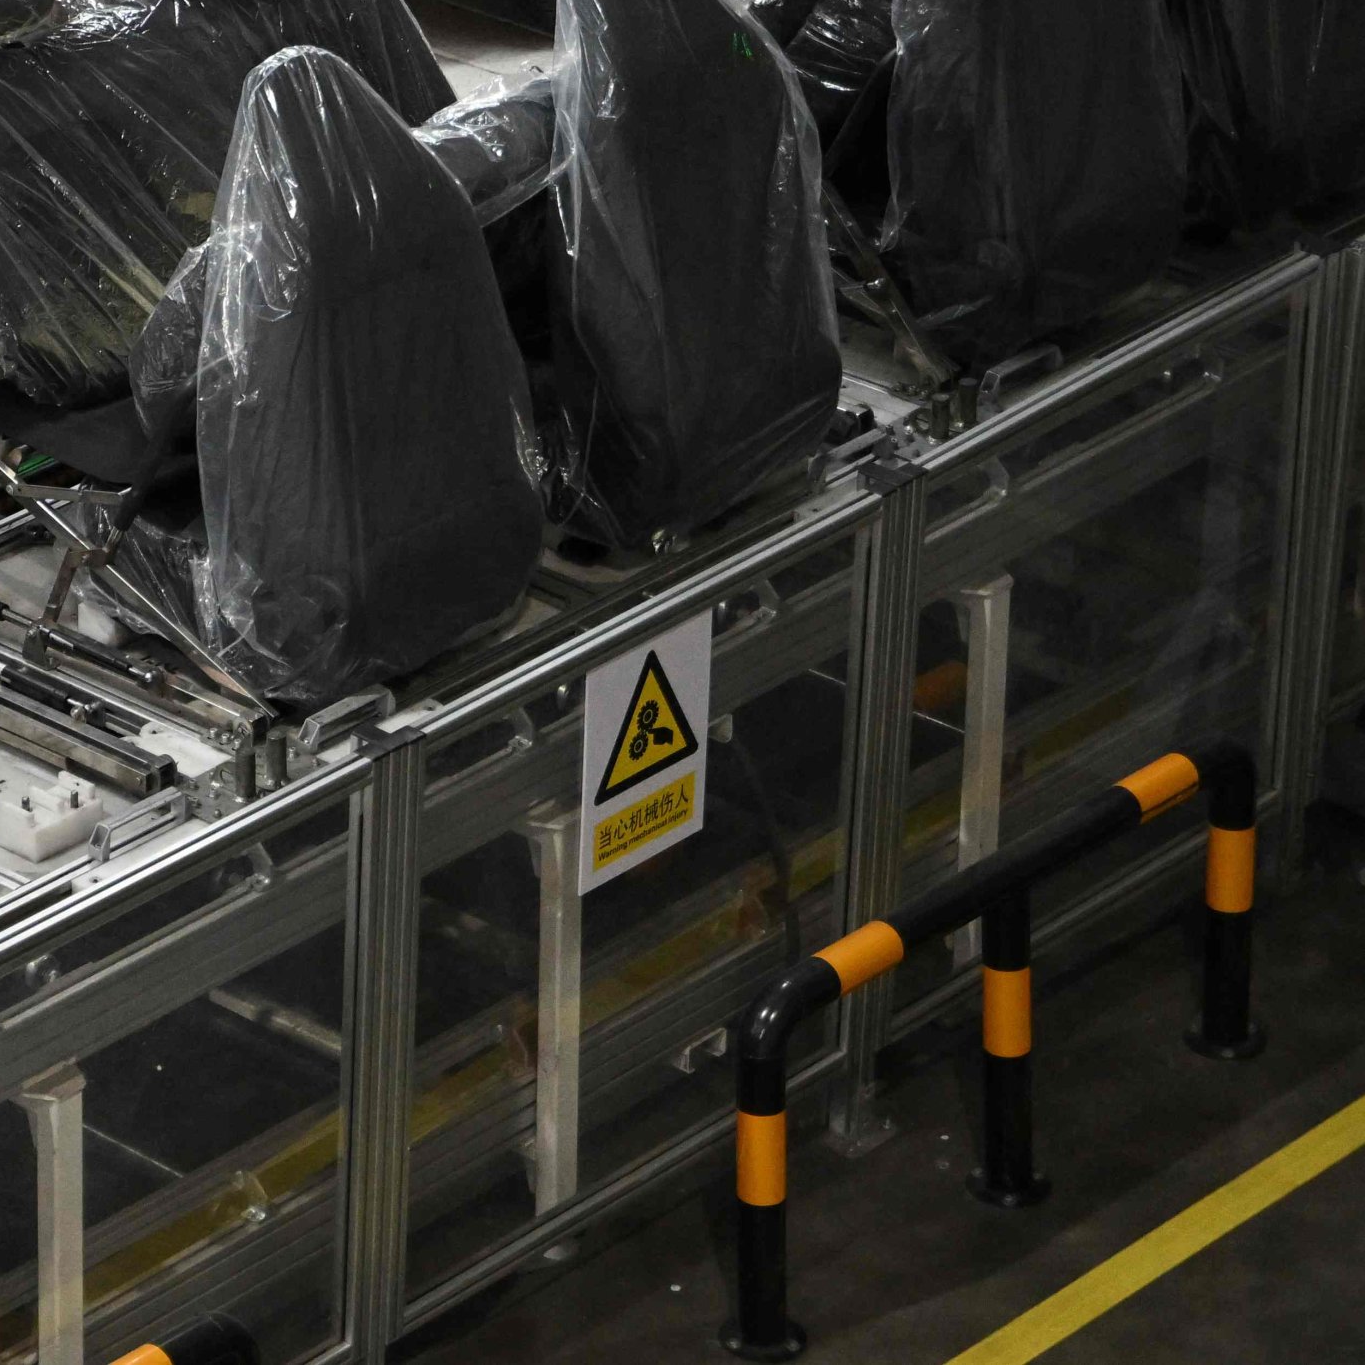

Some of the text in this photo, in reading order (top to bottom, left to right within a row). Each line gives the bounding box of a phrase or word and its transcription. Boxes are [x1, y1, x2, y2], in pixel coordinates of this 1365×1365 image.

[597, 808, 688, 862] Warning mechanical injury
[598, 783, 689, 850] 当心机械伤人
